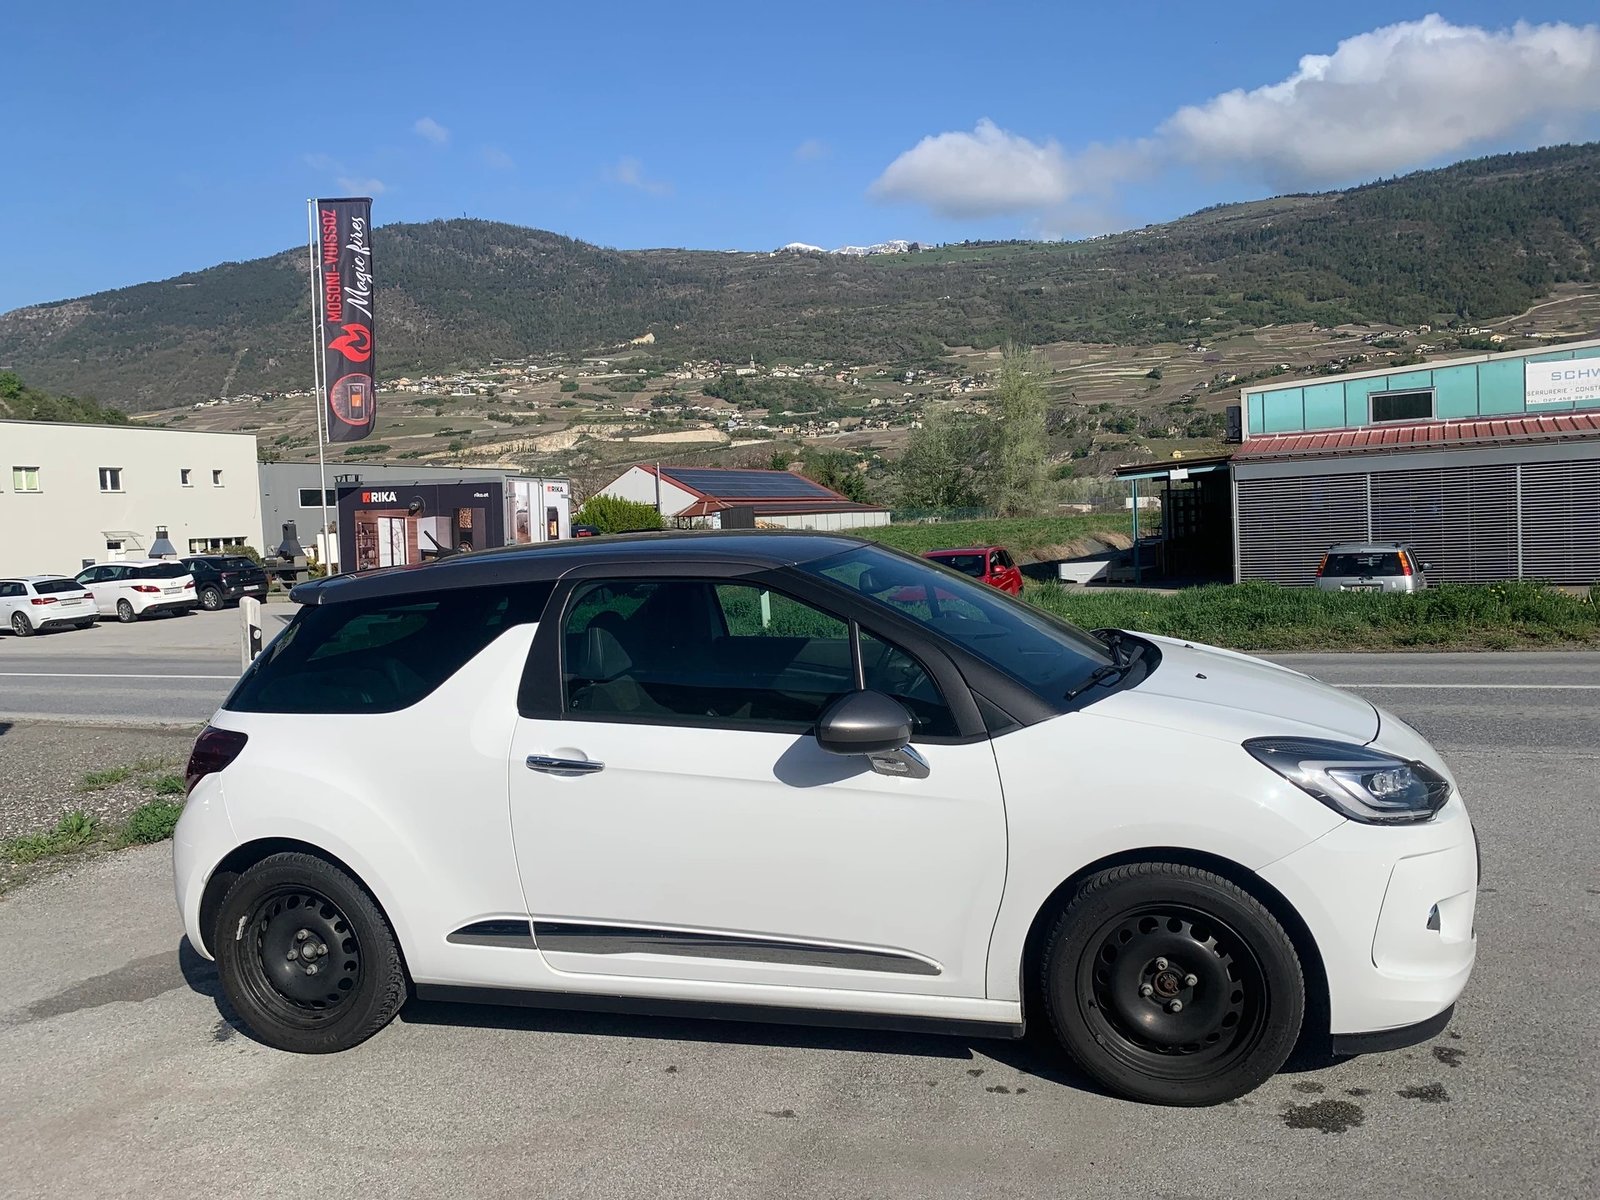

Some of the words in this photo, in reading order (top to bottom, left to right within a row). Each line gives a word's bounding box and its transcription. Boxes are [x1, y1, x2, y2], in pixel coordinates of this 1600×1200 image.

[345, 216, 371, 256] fires
[343, 255, 373, 320] Magic
[1527, 387, 1568, 397] SERRURERIE
[551, 485, 564, 493] RIKA
[370, 491, 397, 503] RIKA
